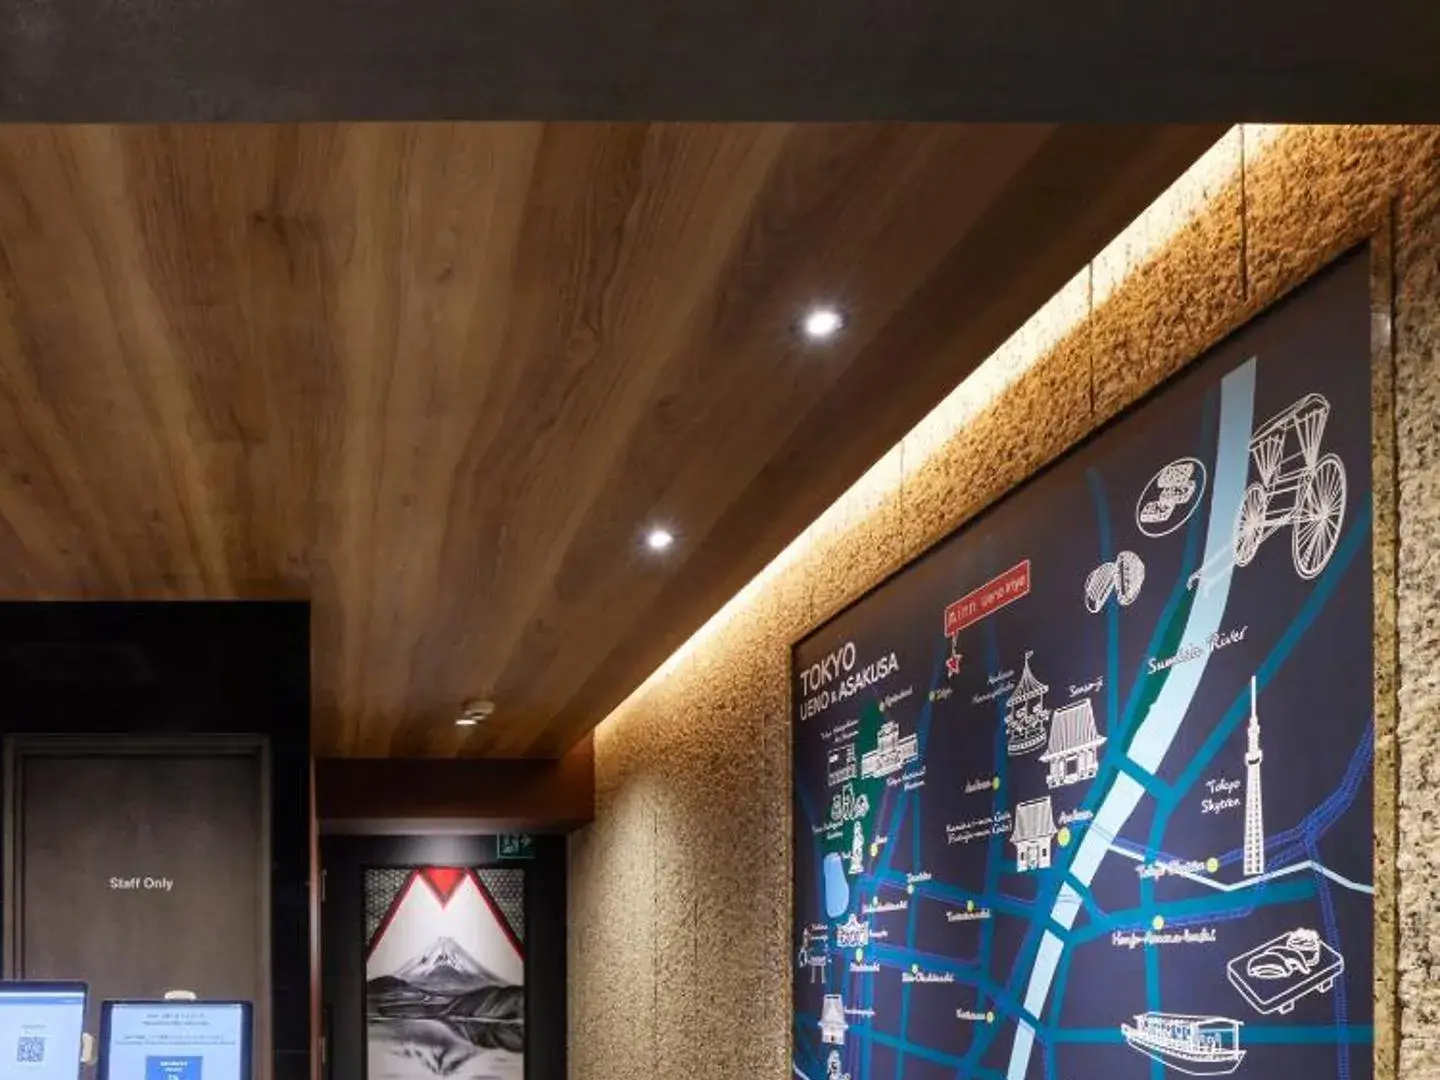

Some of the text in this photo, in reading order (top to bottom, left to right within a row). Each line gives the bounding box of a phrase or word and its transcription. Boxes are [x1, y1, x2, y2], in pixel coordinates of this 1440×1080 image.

[800, 641, 857, 696] TOKYO
[838, 652, 900, 703] ASAKUSA
[110, 876, 174, 892] Staff Only
